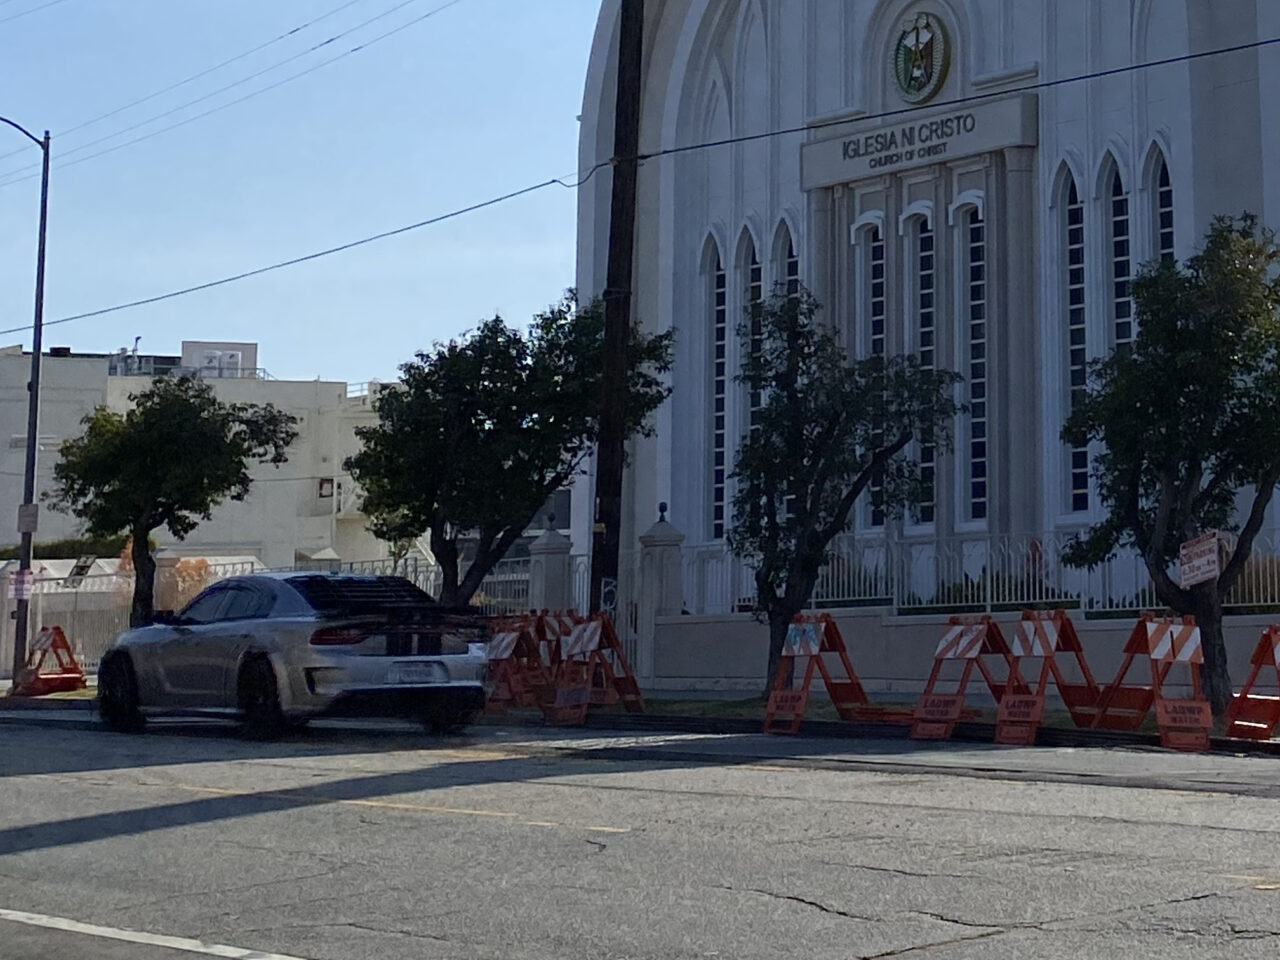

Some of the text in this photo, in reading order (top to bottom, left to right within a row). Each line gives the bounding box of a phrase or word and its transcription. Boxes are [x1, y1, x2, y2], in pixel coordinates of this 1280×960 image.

[843, 113, 976, 160] IGLESIA NI CRISTO
[869, 142, 948, 169] CHURCH OF CHRIST
[923, 699, 957, 708] LADWP
[1005, 699, 1037, 709] LADWP
[1164, 704, 1203, 715] LADWP
[1171, 716, 1201, 724] WATER
